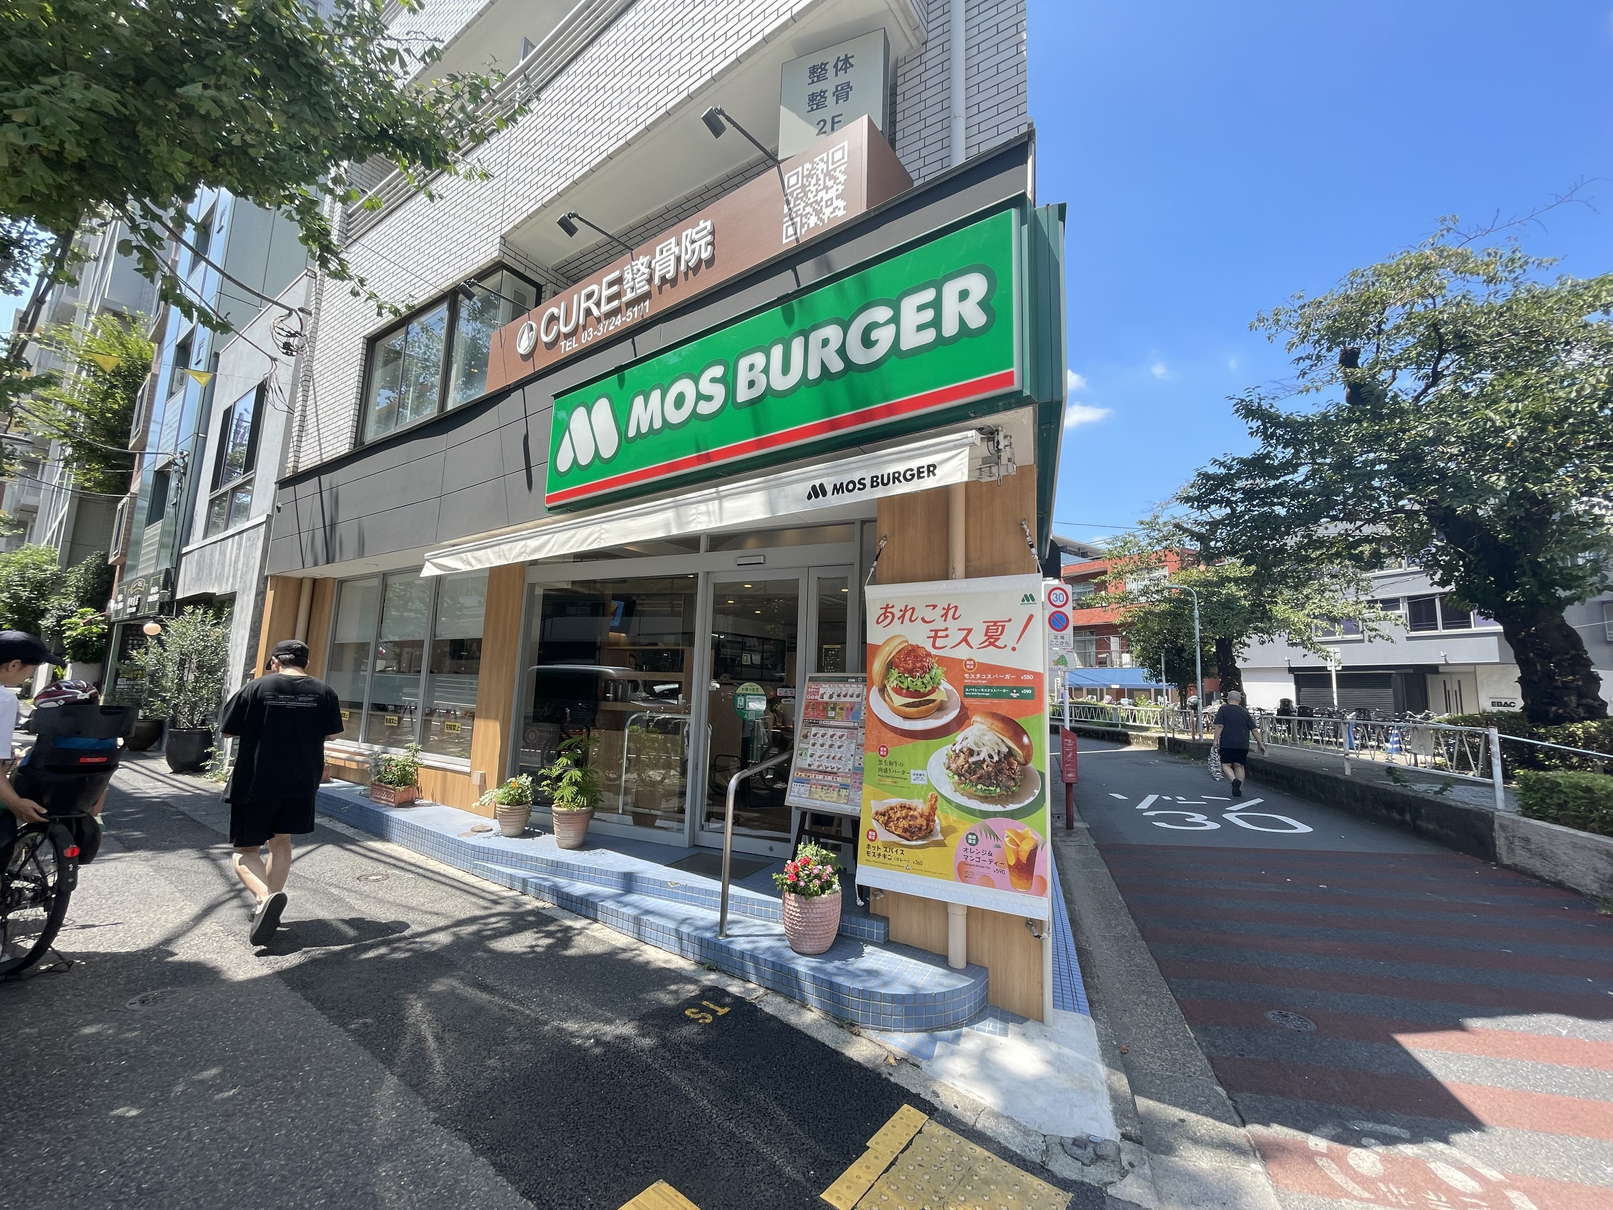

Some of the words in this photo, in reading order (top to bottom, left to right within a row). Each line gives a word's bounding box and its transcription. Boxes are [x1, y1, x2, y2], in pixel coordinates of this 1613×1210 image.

[807, 53, 855, 86] 整体
[807, 80, 854, 113] 整骨
[816, 112, 844, 136] 2F
[559, 336, 579, 354] TEL
[626, 363, 727, 439] MOS
[736, 271, 990, 403] BURGER
[831, 477, 867, 496] MOS
[870, 463, 938, 489] BURGER
[1051, 592, 1065, 604] 30
[875, 603, 962, 629] あれこれ
[1142, 810, 1315, 834] 30
